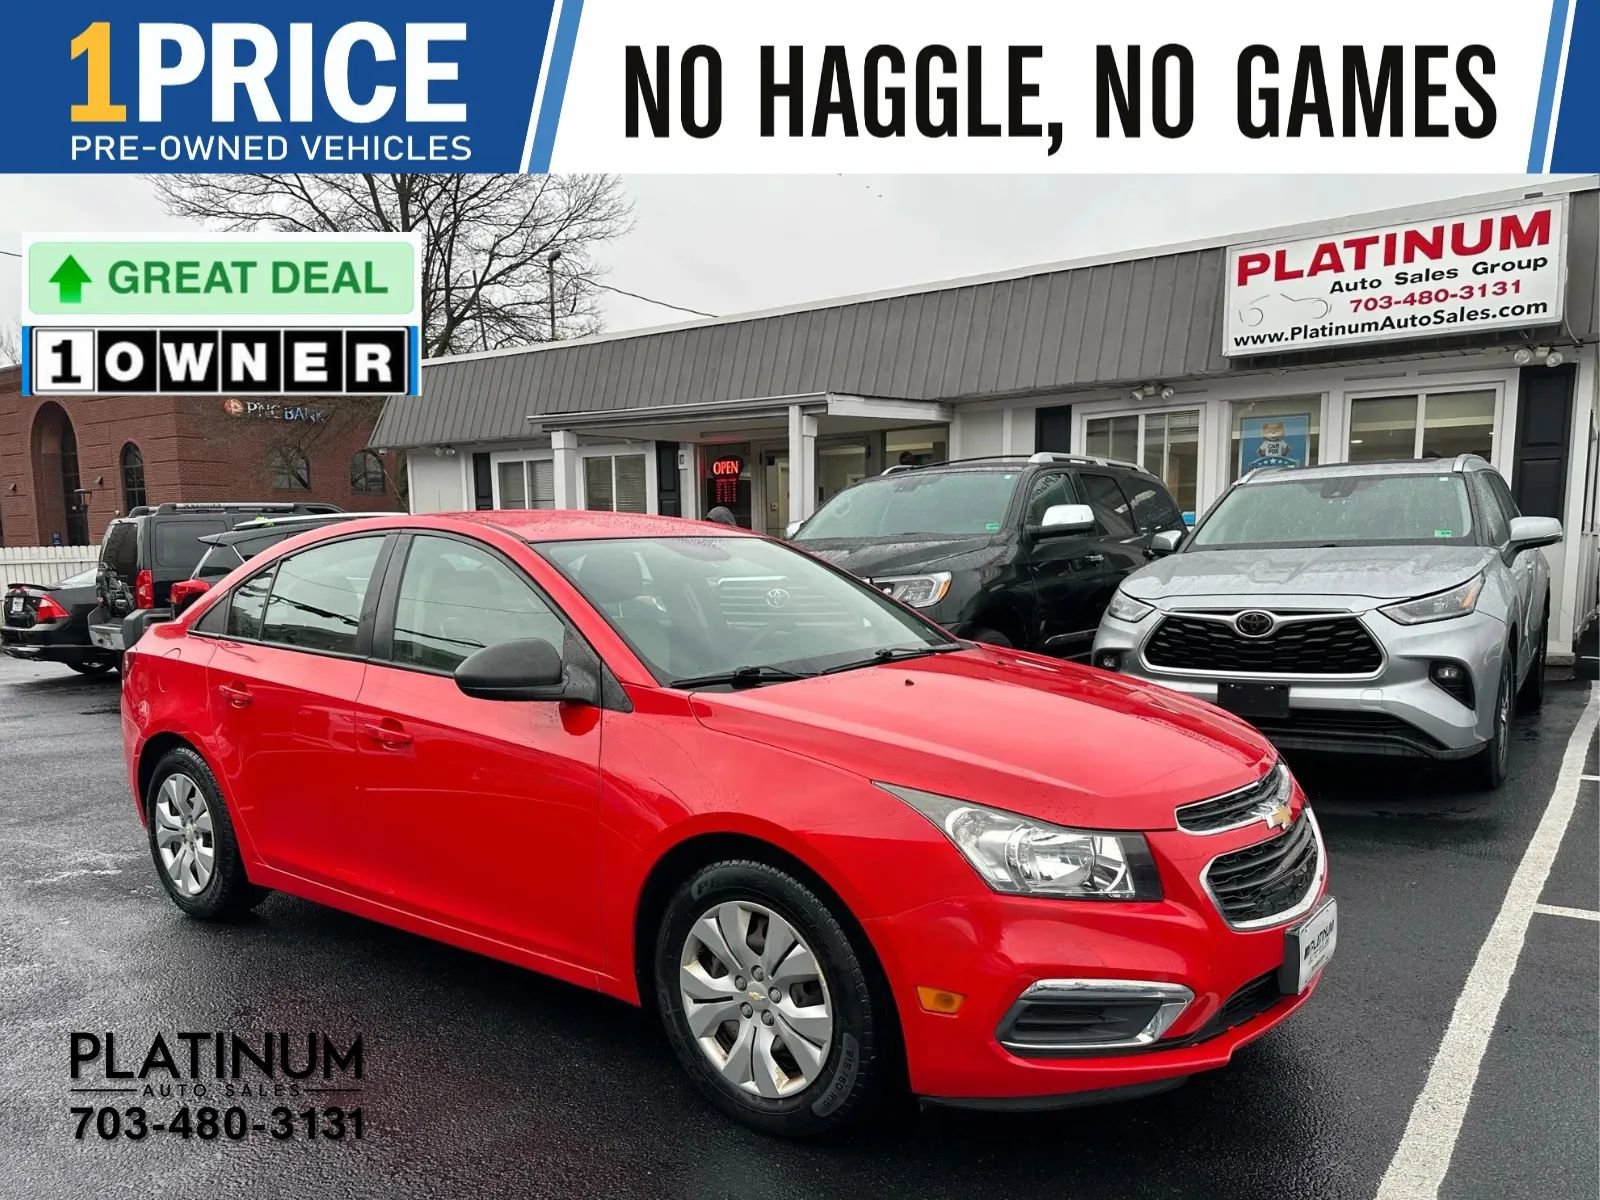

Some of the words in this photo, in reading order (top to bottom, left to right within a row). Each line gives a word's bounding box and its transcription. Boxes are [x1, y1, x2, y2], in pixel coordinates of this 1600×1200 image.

[1237, 209, 1552, 286] PLATINUM
[1330, 277, 1382, 294] Auto
[1394, 266, 1459, 286] Sales
[1471, 256, 1548, 276] Group
[1350, 279, 1521, 313] 703-480-3131
[1234, 301, 1548, 347] www.PlatinumAutoSales.com
[713, 461, 738, 475] OPEN
